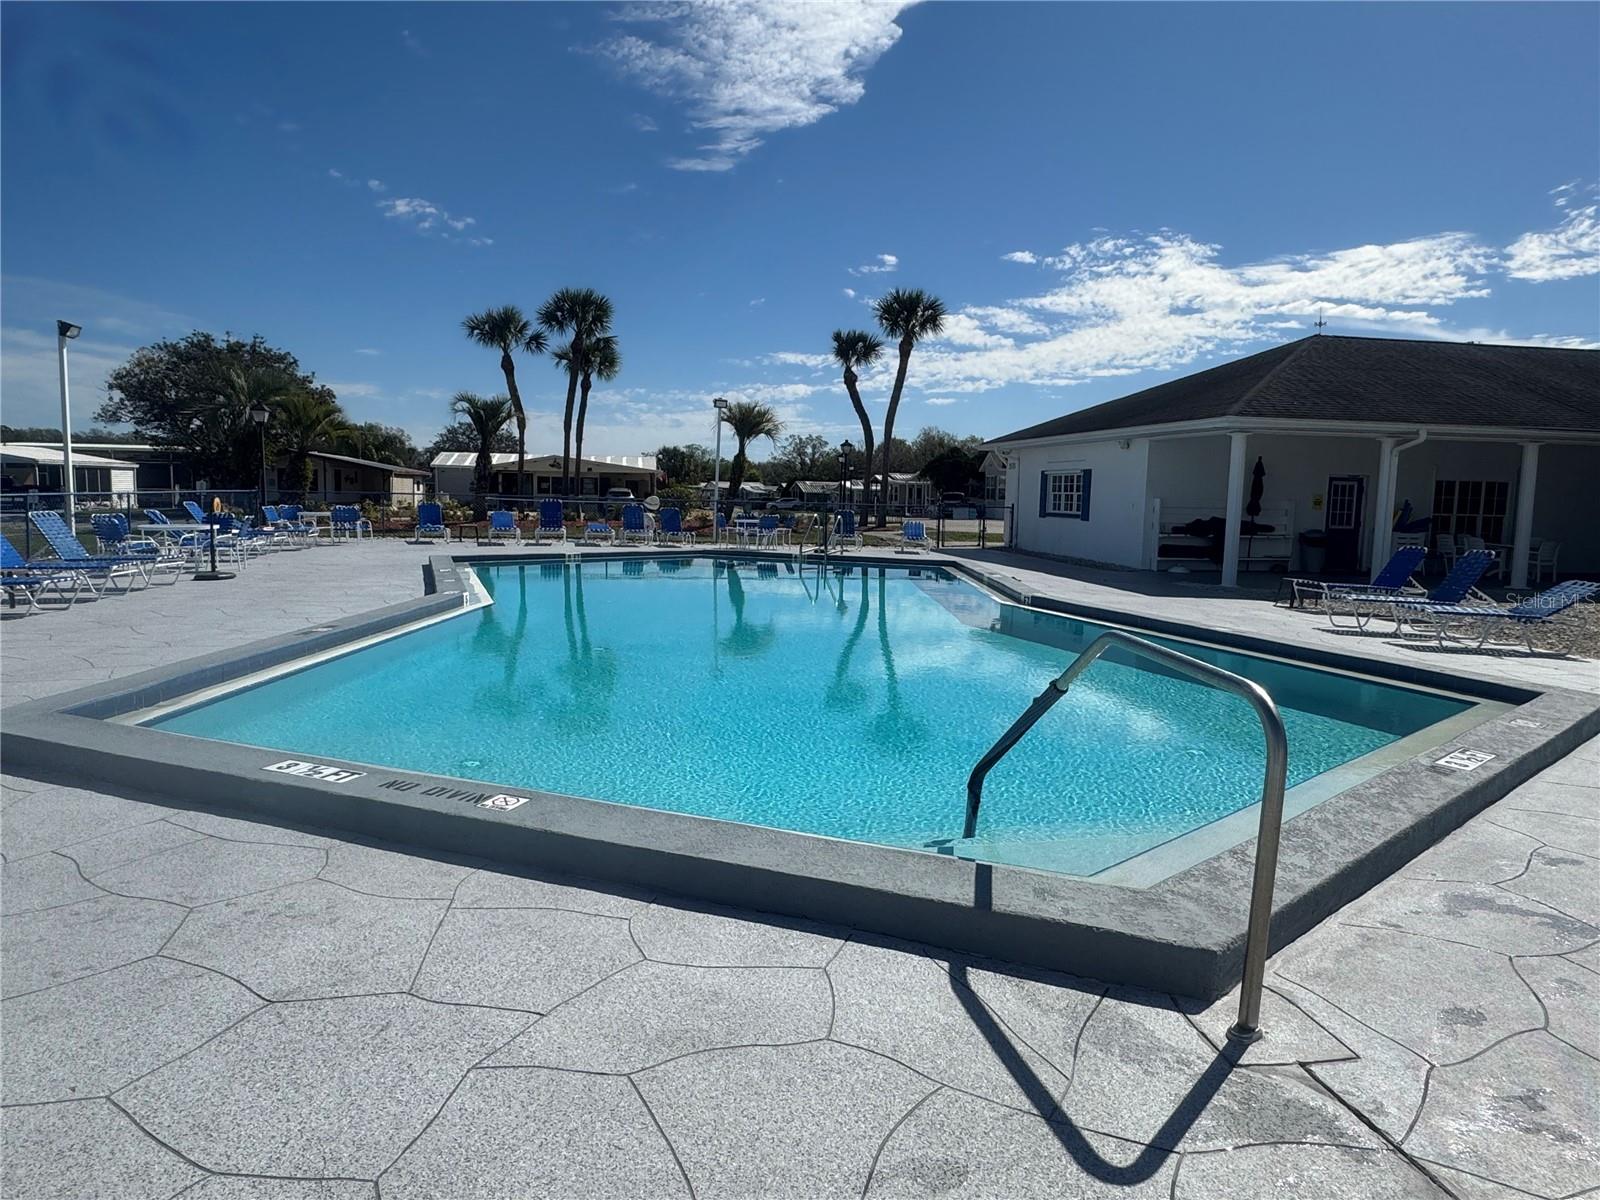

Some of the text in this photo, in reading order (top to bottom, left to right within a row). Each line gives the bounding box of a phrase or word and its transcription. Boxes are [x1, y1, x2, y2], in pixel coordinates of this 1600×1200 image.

[320, 769, 364, 782] FT
[378, 779, 493, 804] NO DIVIN
